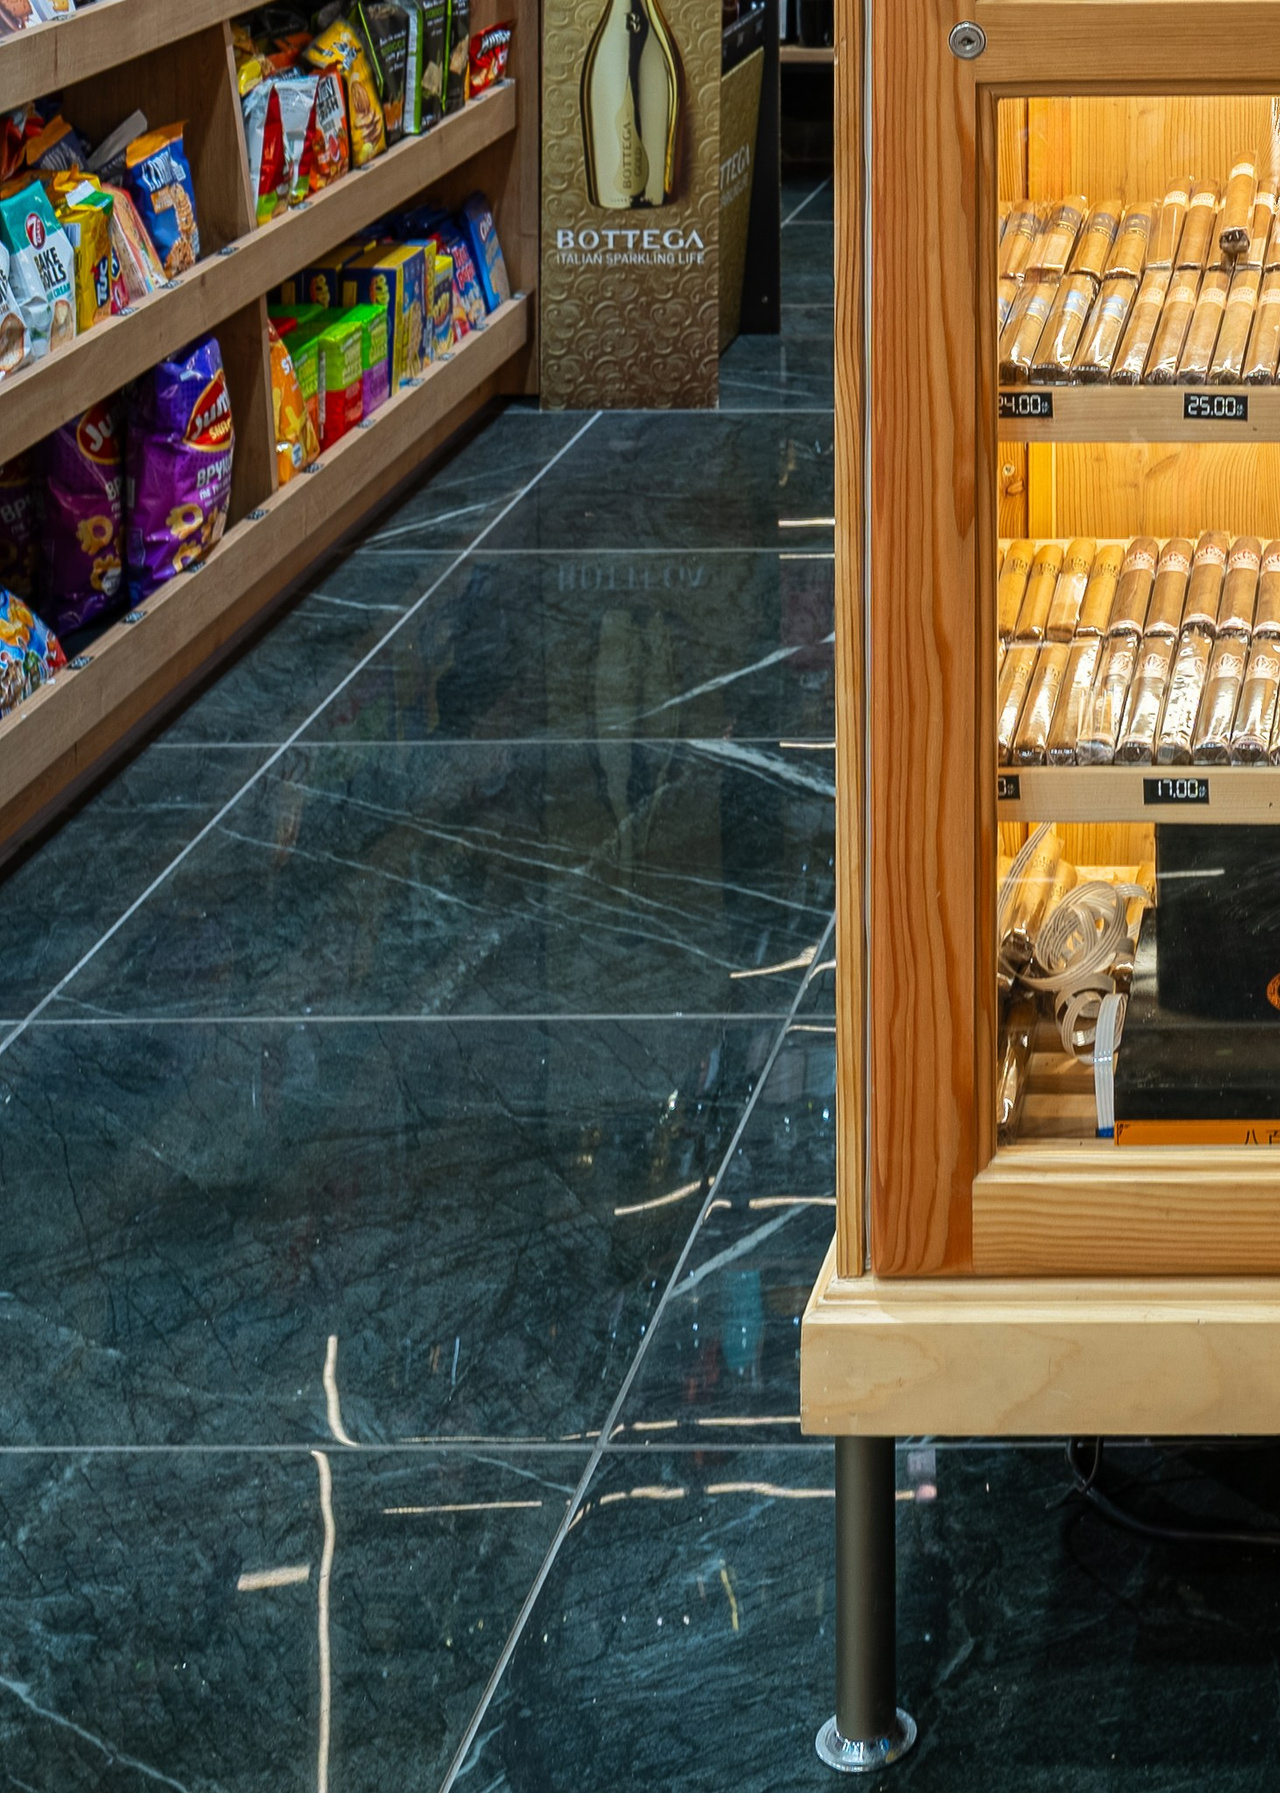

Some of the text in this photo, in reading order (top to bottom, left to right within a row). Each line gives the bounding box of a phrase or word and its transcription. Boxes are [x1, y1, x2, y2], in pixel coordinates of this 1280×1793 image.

[556, 228, 705, 250] BOTTEGA
[557, 252, 705, 266] ITALIAN SPARKLING LIFE
[96, 257, 110, 307] TUC
[1188, 396, 1236, 416] 25.00
[1157, 779, 1198, 798] 17.00
